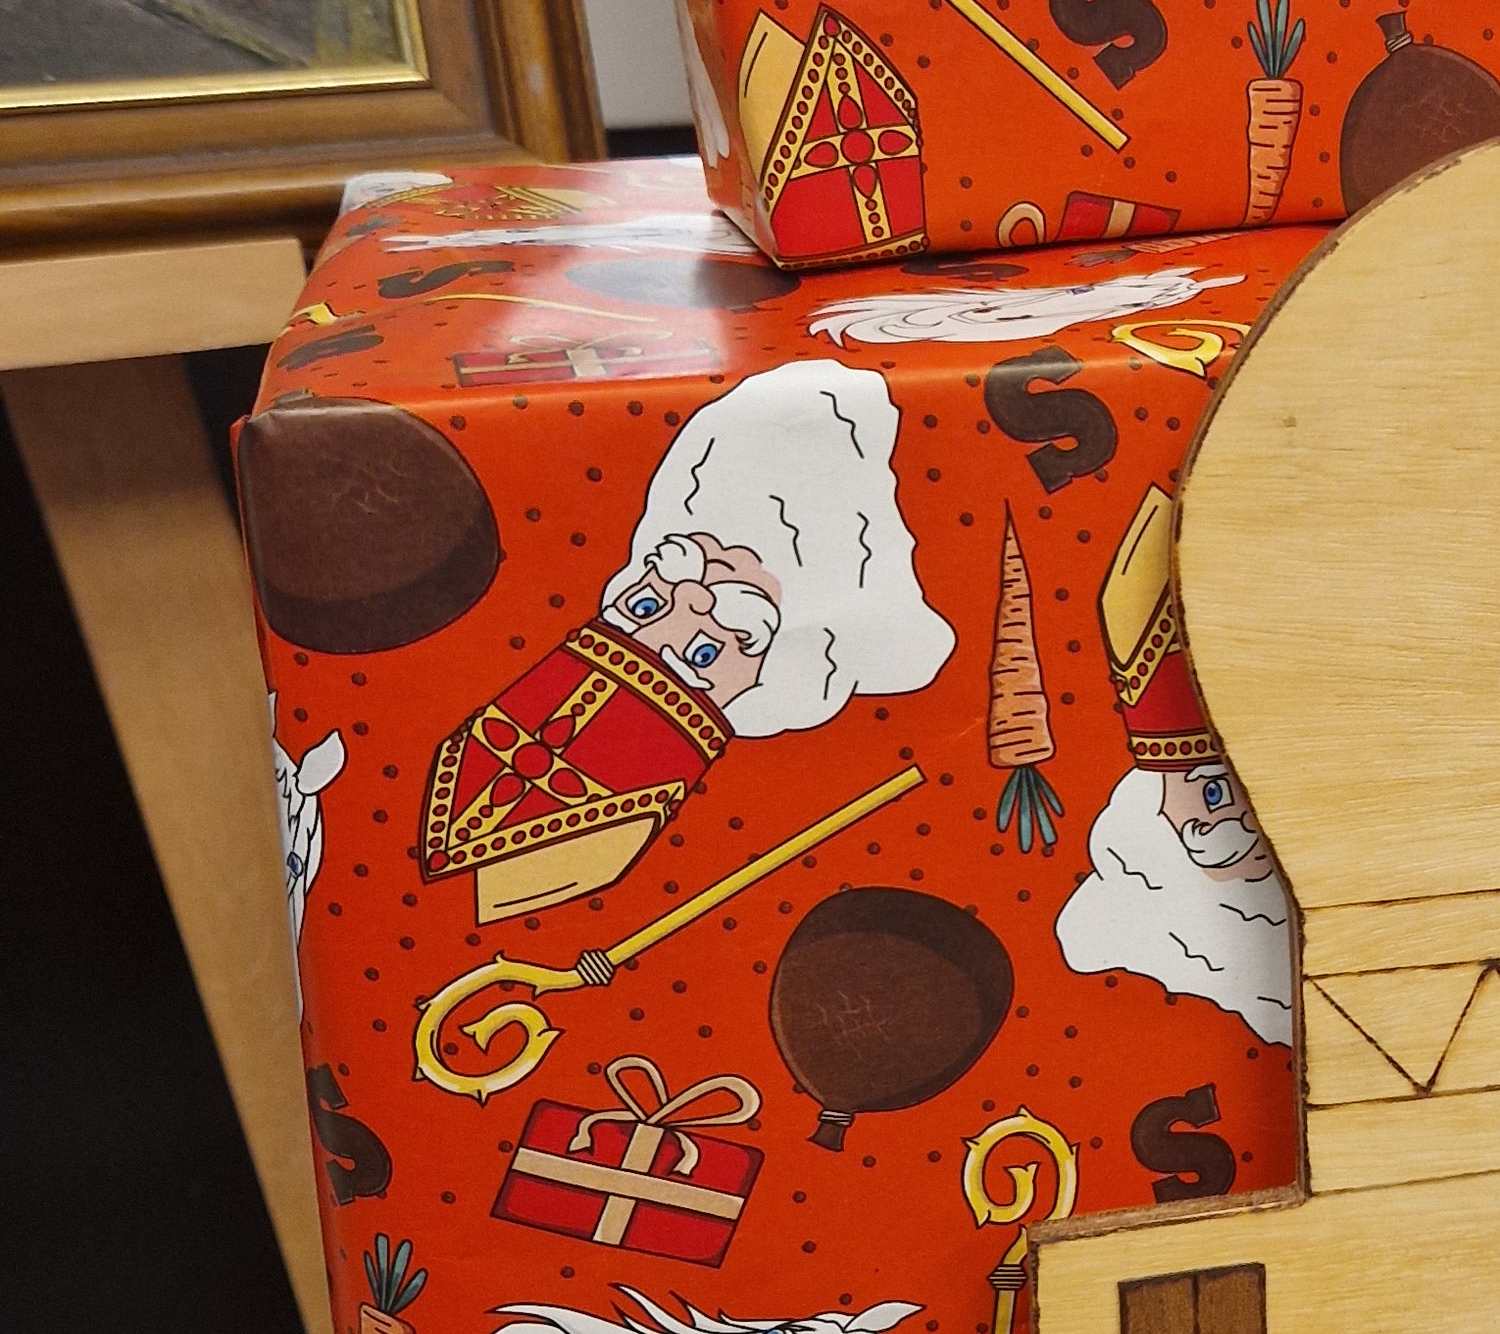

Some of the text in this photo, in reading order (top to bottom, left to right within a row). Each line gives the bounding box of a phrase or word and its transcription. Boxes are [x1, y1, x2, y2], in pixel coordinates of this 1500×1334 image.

[984, 344, 1118, 494] S
[307, 1062, 392, 1206] S
[1130, 1082, 1236, 1204] S
